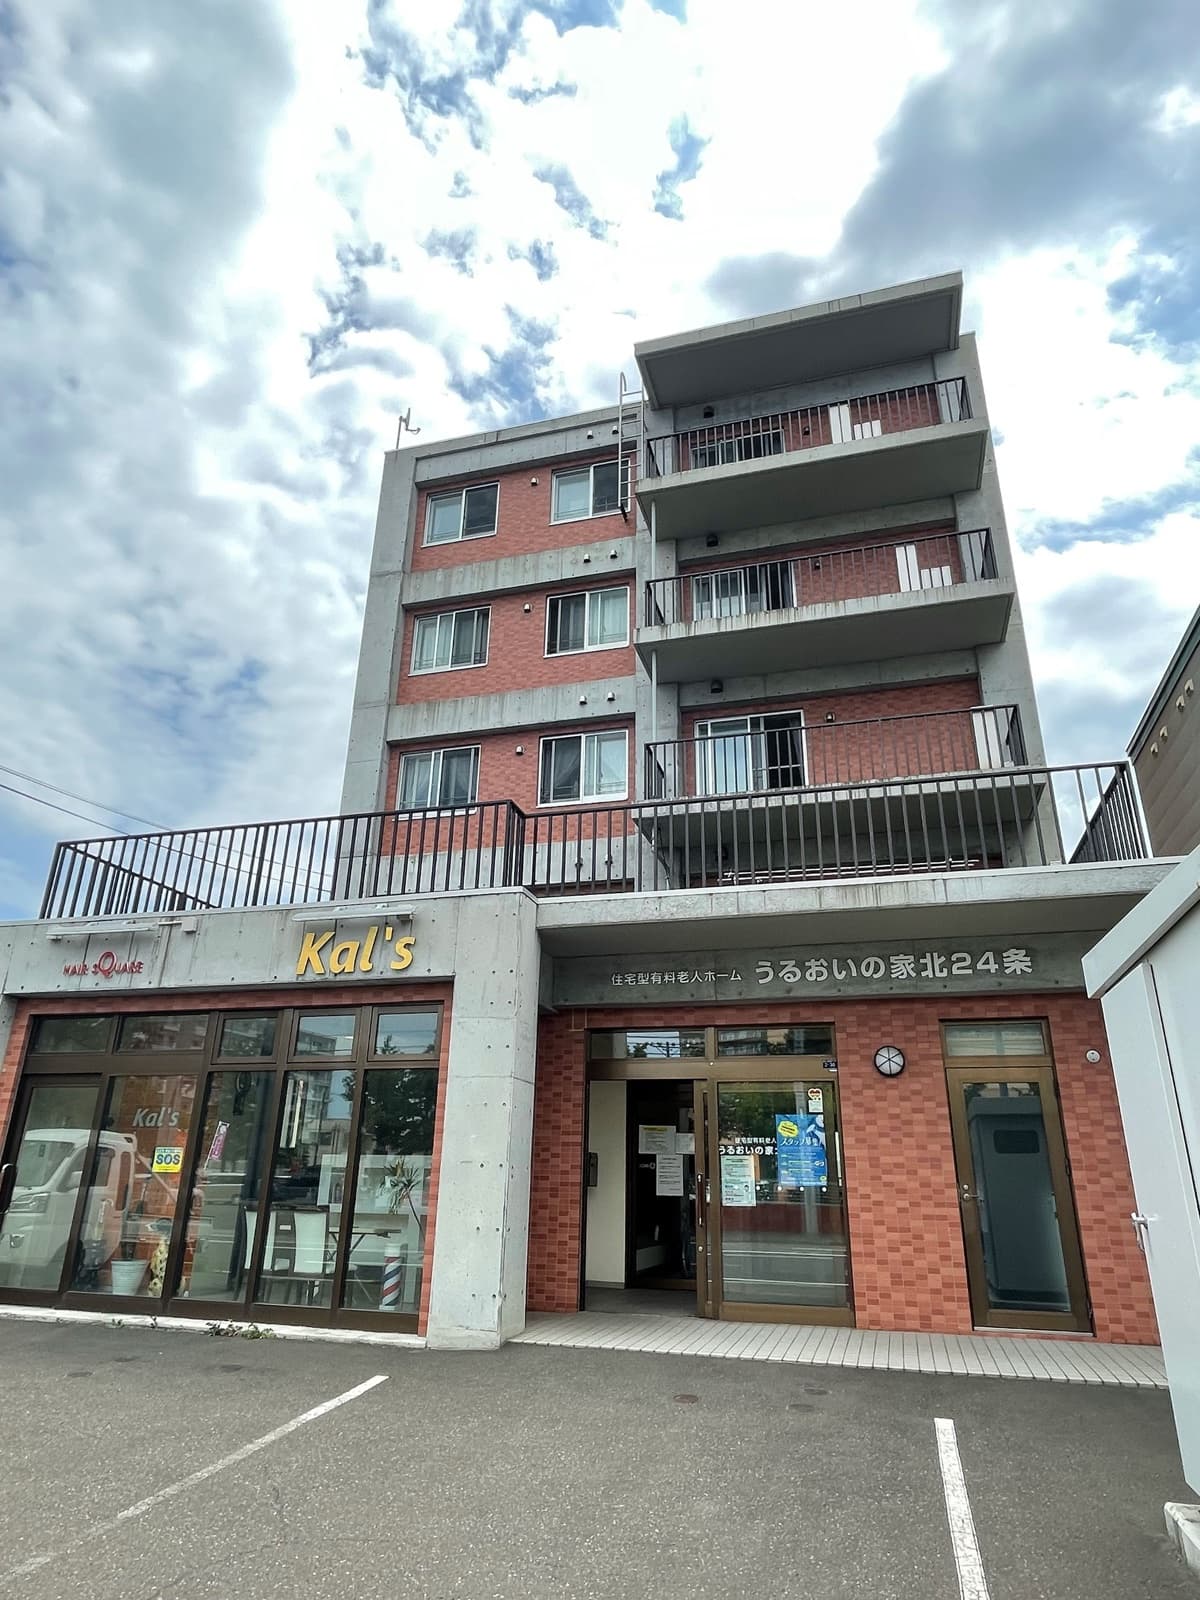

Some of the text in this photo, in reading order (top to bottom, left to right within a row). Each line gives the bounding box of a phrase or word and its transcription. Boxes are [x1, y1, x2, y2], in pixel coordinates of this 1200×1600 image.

[296, 926, 416, 975] Kal's
[63, 963, 88, 976] HAIR
[755, 948, 1033, 984] うるおいの家北24条
[611, 970, 742, 986] 住宅型有料老人ホーム
[132, 1106, 180, 1127] Kal's
[155, 1154, 181, 1165] SOS
